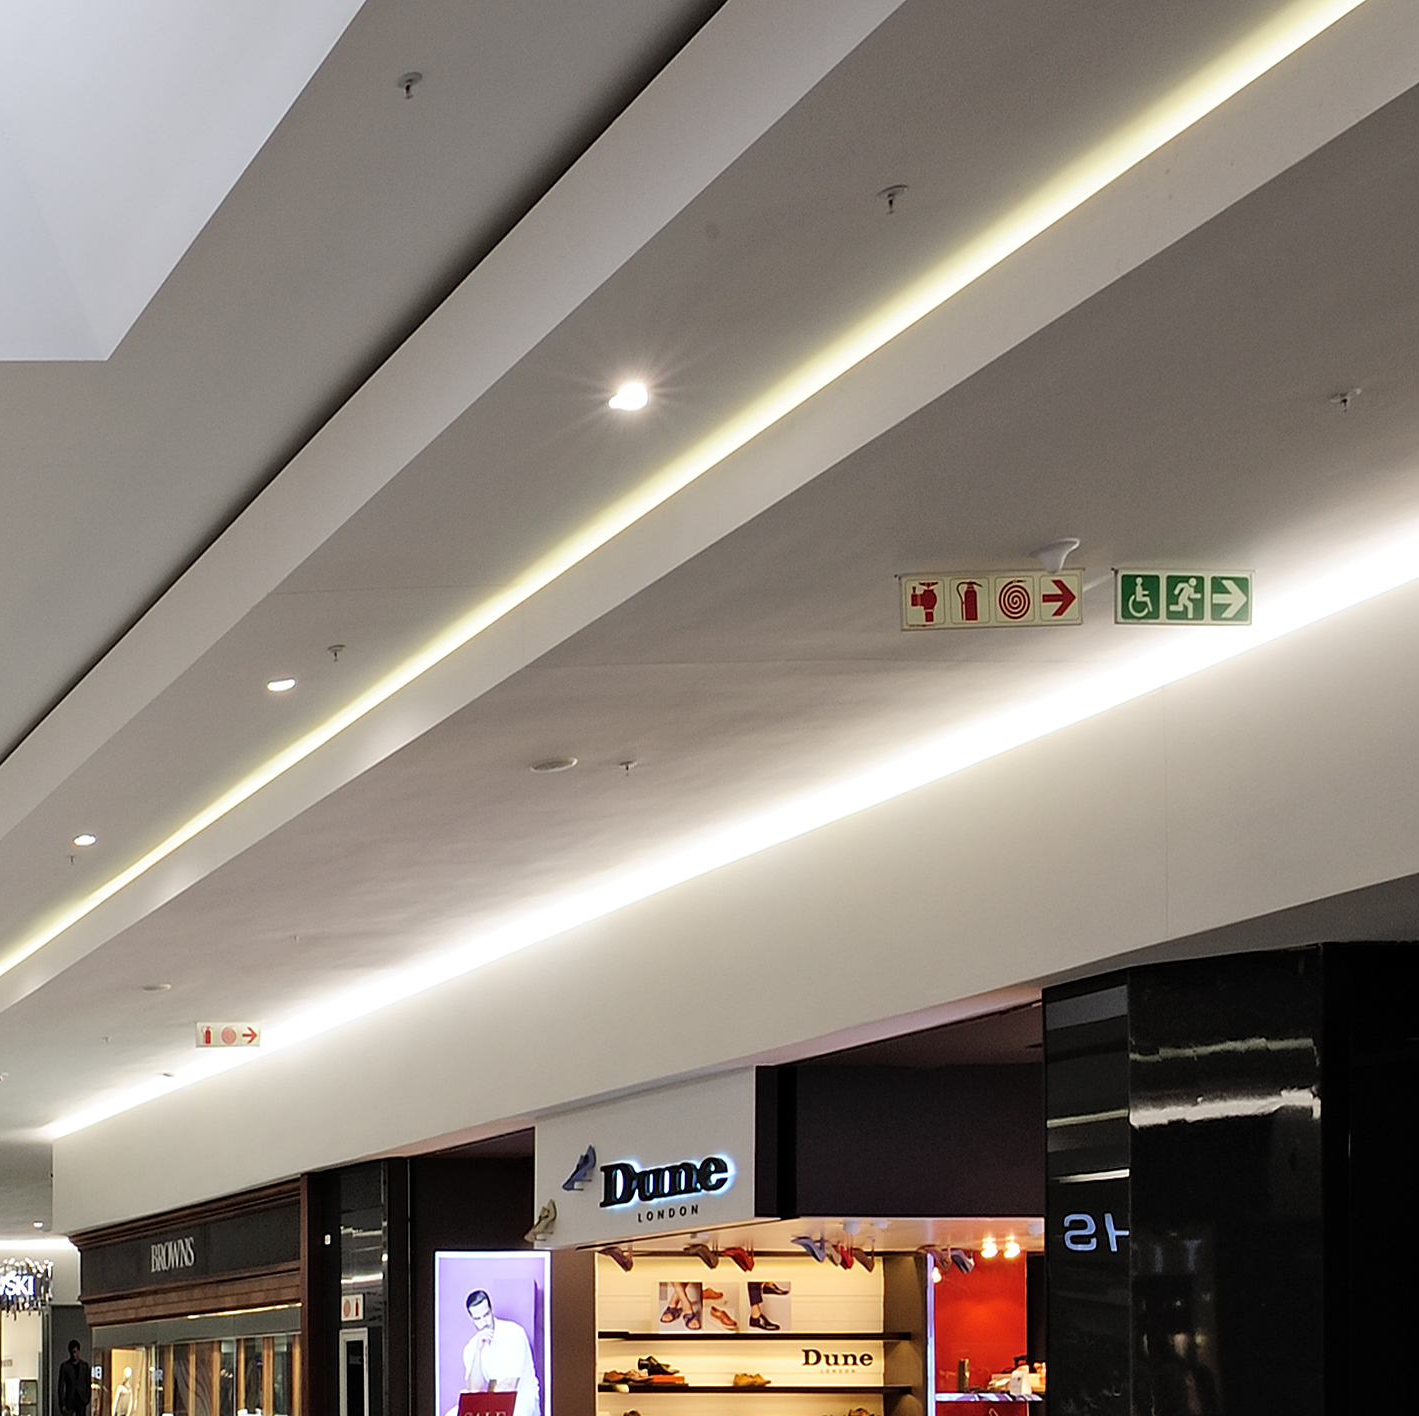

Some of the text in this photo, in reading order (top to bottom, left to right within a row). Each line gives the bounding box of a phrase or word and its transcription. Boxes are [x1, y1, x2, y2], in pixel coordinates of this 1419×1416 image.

[599, 1157, 729, 1208] Dune
[637, 1203, 700, 1223] LONDON
[151, 1236, 195, 1272] BROWNS
[801, 1348, 874, 1367] Dune
